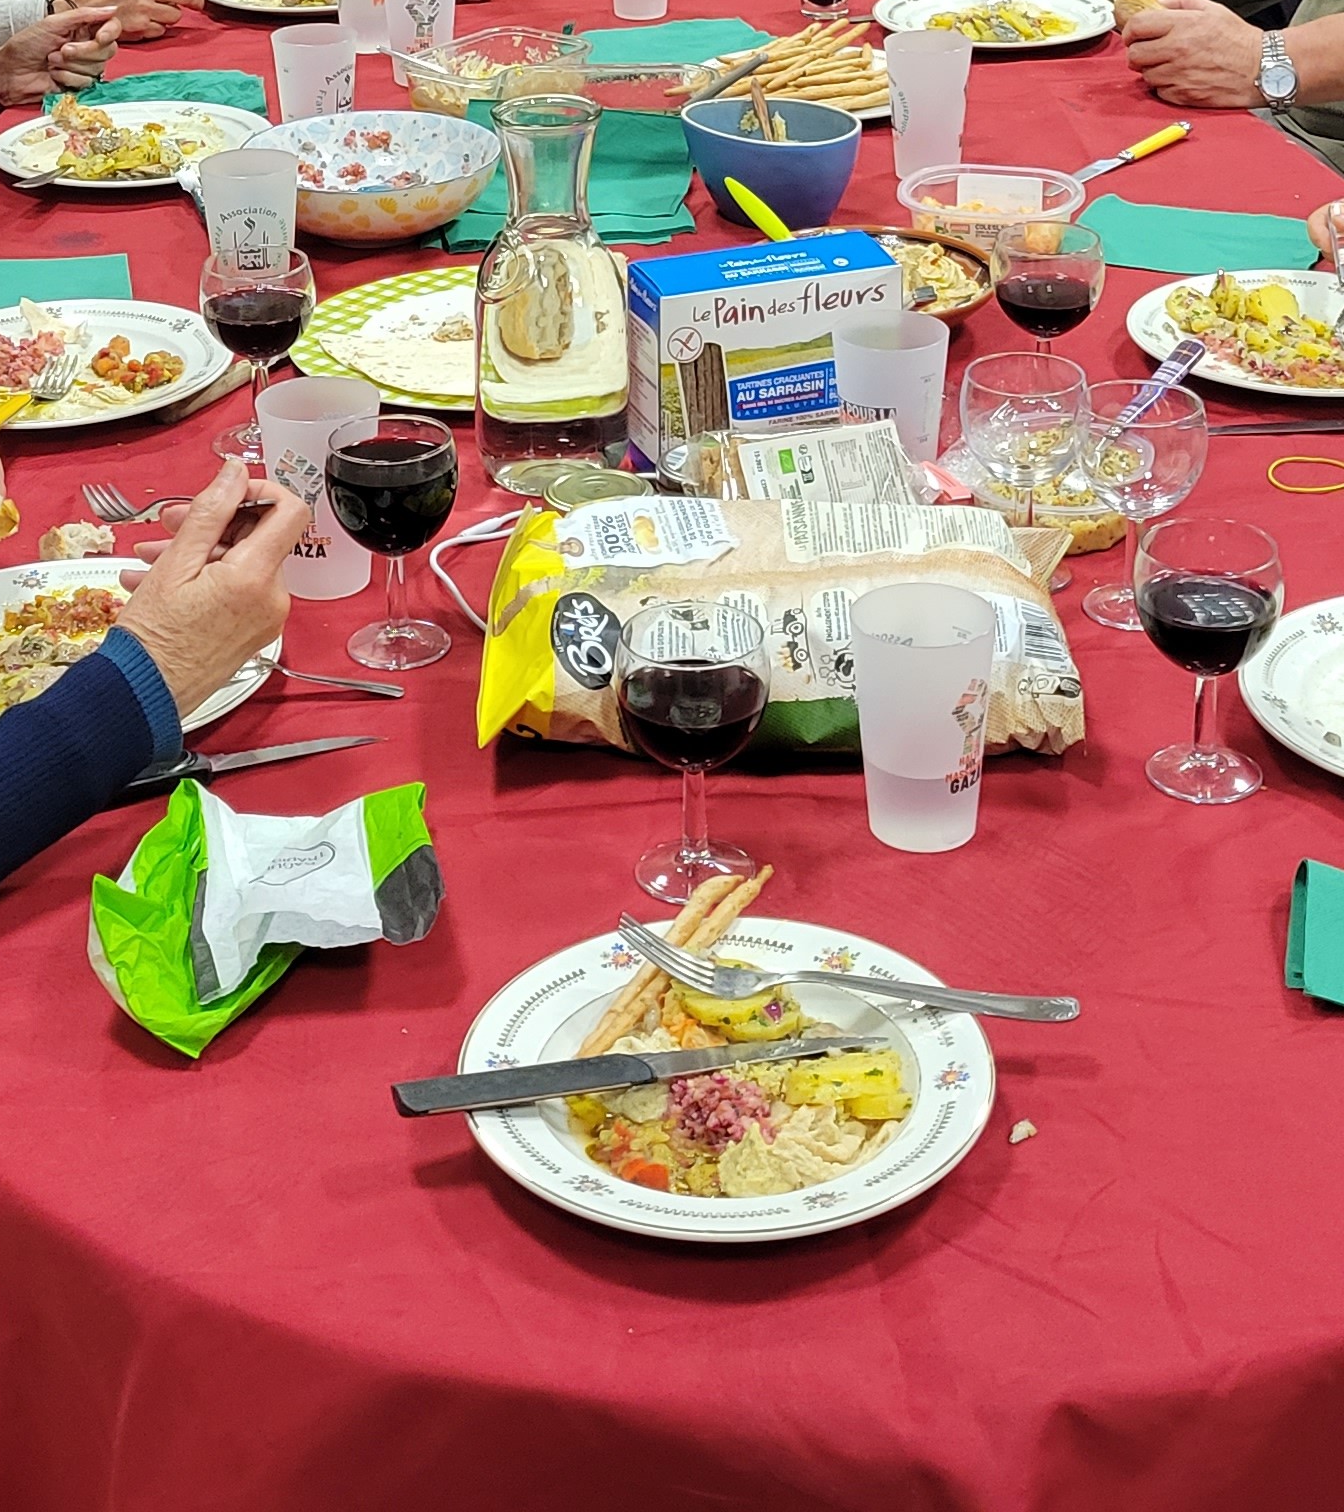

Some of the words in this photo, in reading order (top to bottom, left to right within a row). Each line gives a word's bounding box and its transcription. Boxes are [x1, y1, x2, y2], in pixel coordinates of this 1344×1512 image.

[315, 89, 327, 113] Fran
[219, 206, 278, 224] Association
[693, 306, 711, 322] Le
[714, 297, 765, 328] Pain
[767, 301, 796, 317] des
[796, 282, 888, 315] fleurs
[736, 378, 772, 390] TARTINES
[773, 370, 824, 385] CRAQUANTES
[737, 390, 755, 403] AU
[758, 379, 824, 398] SARRASIN
[816, 409, 839, 418] SARRA
